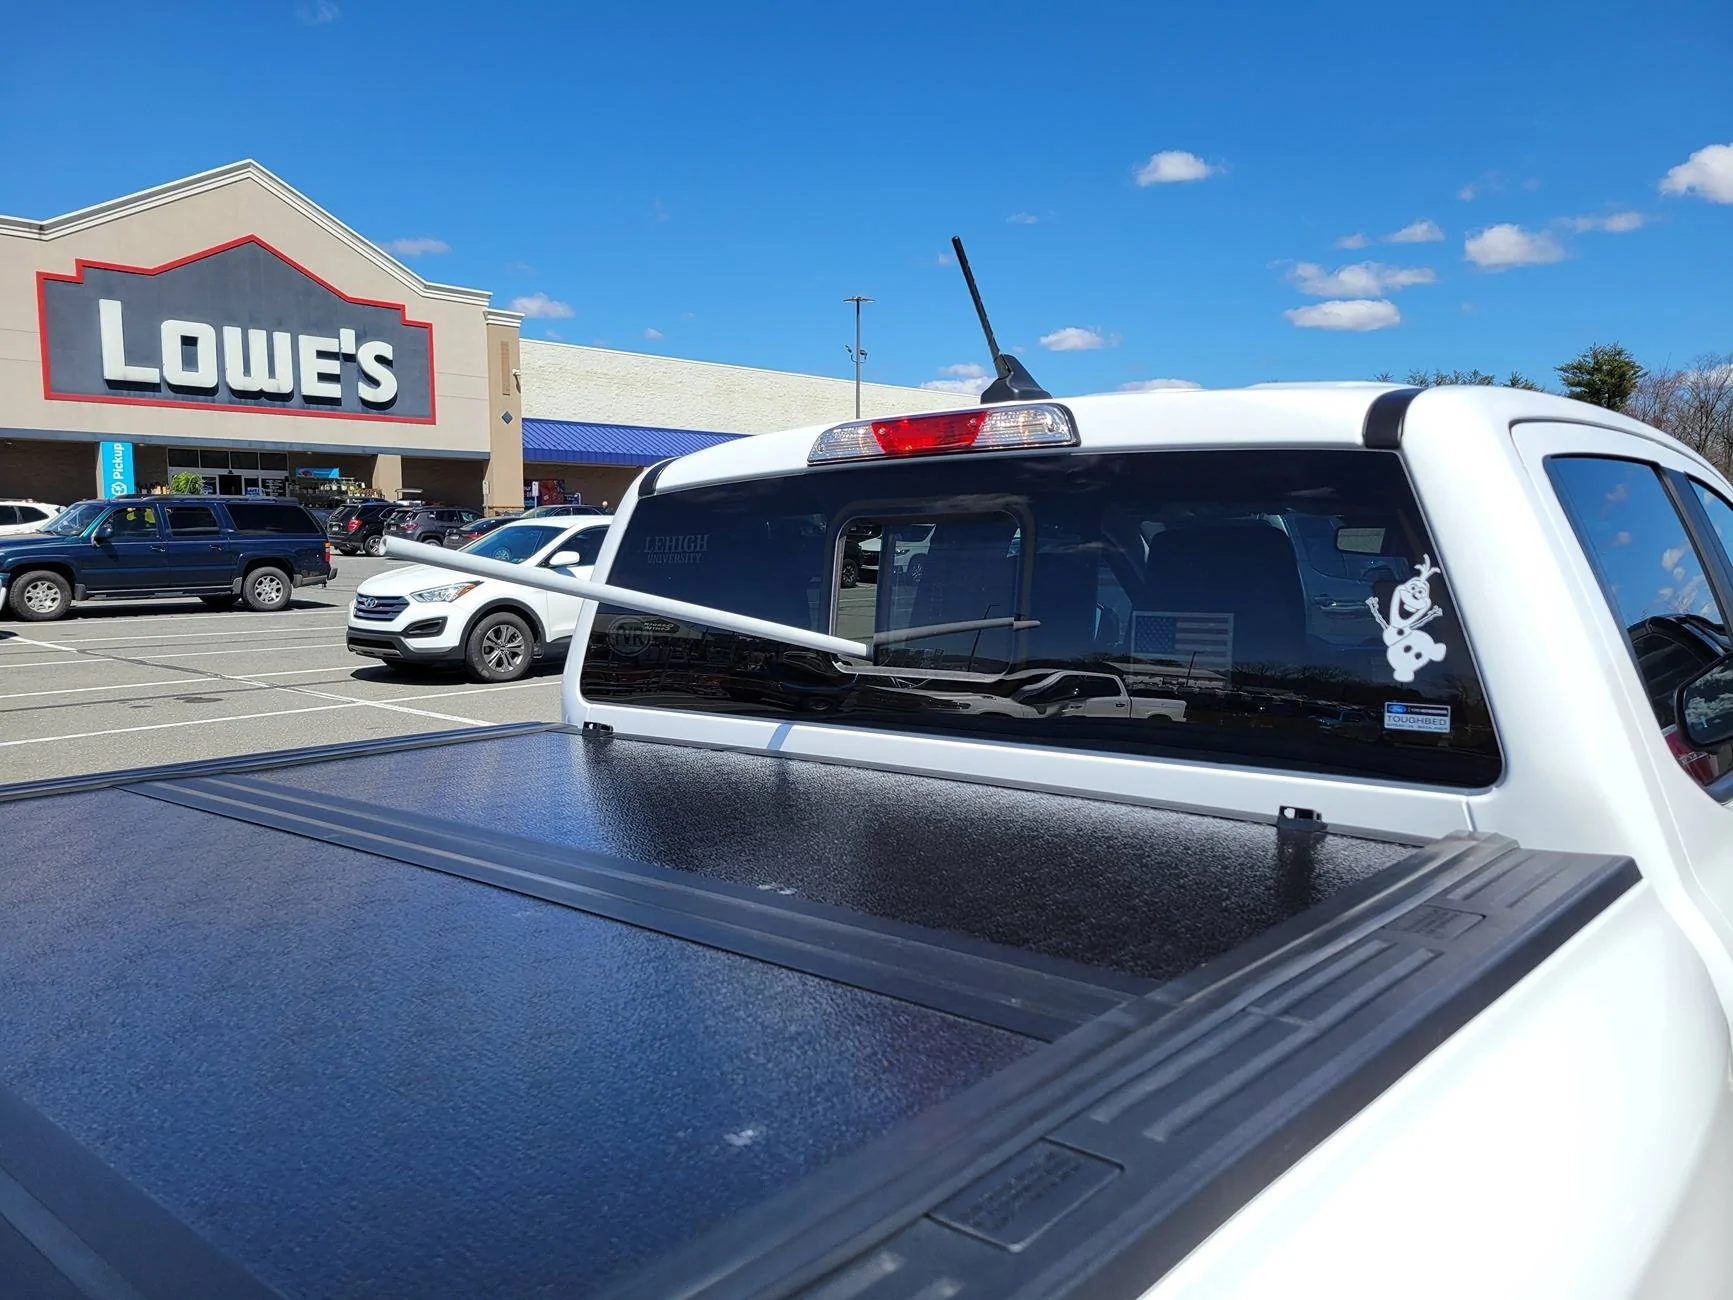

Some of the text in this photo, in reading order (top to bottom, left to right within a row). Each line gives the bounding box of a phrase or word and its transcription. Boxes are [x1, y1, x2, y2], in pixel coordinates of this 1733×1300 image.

[99, 298, 399, 403] LOWE'S
[112, 443, 125, 480] Pickup
[643, 534, 710, 553] LEHIGH
[647, 552, 703, 564] UNIVERSITY
[1387, 715, 1447, 725] TOUGHBED
